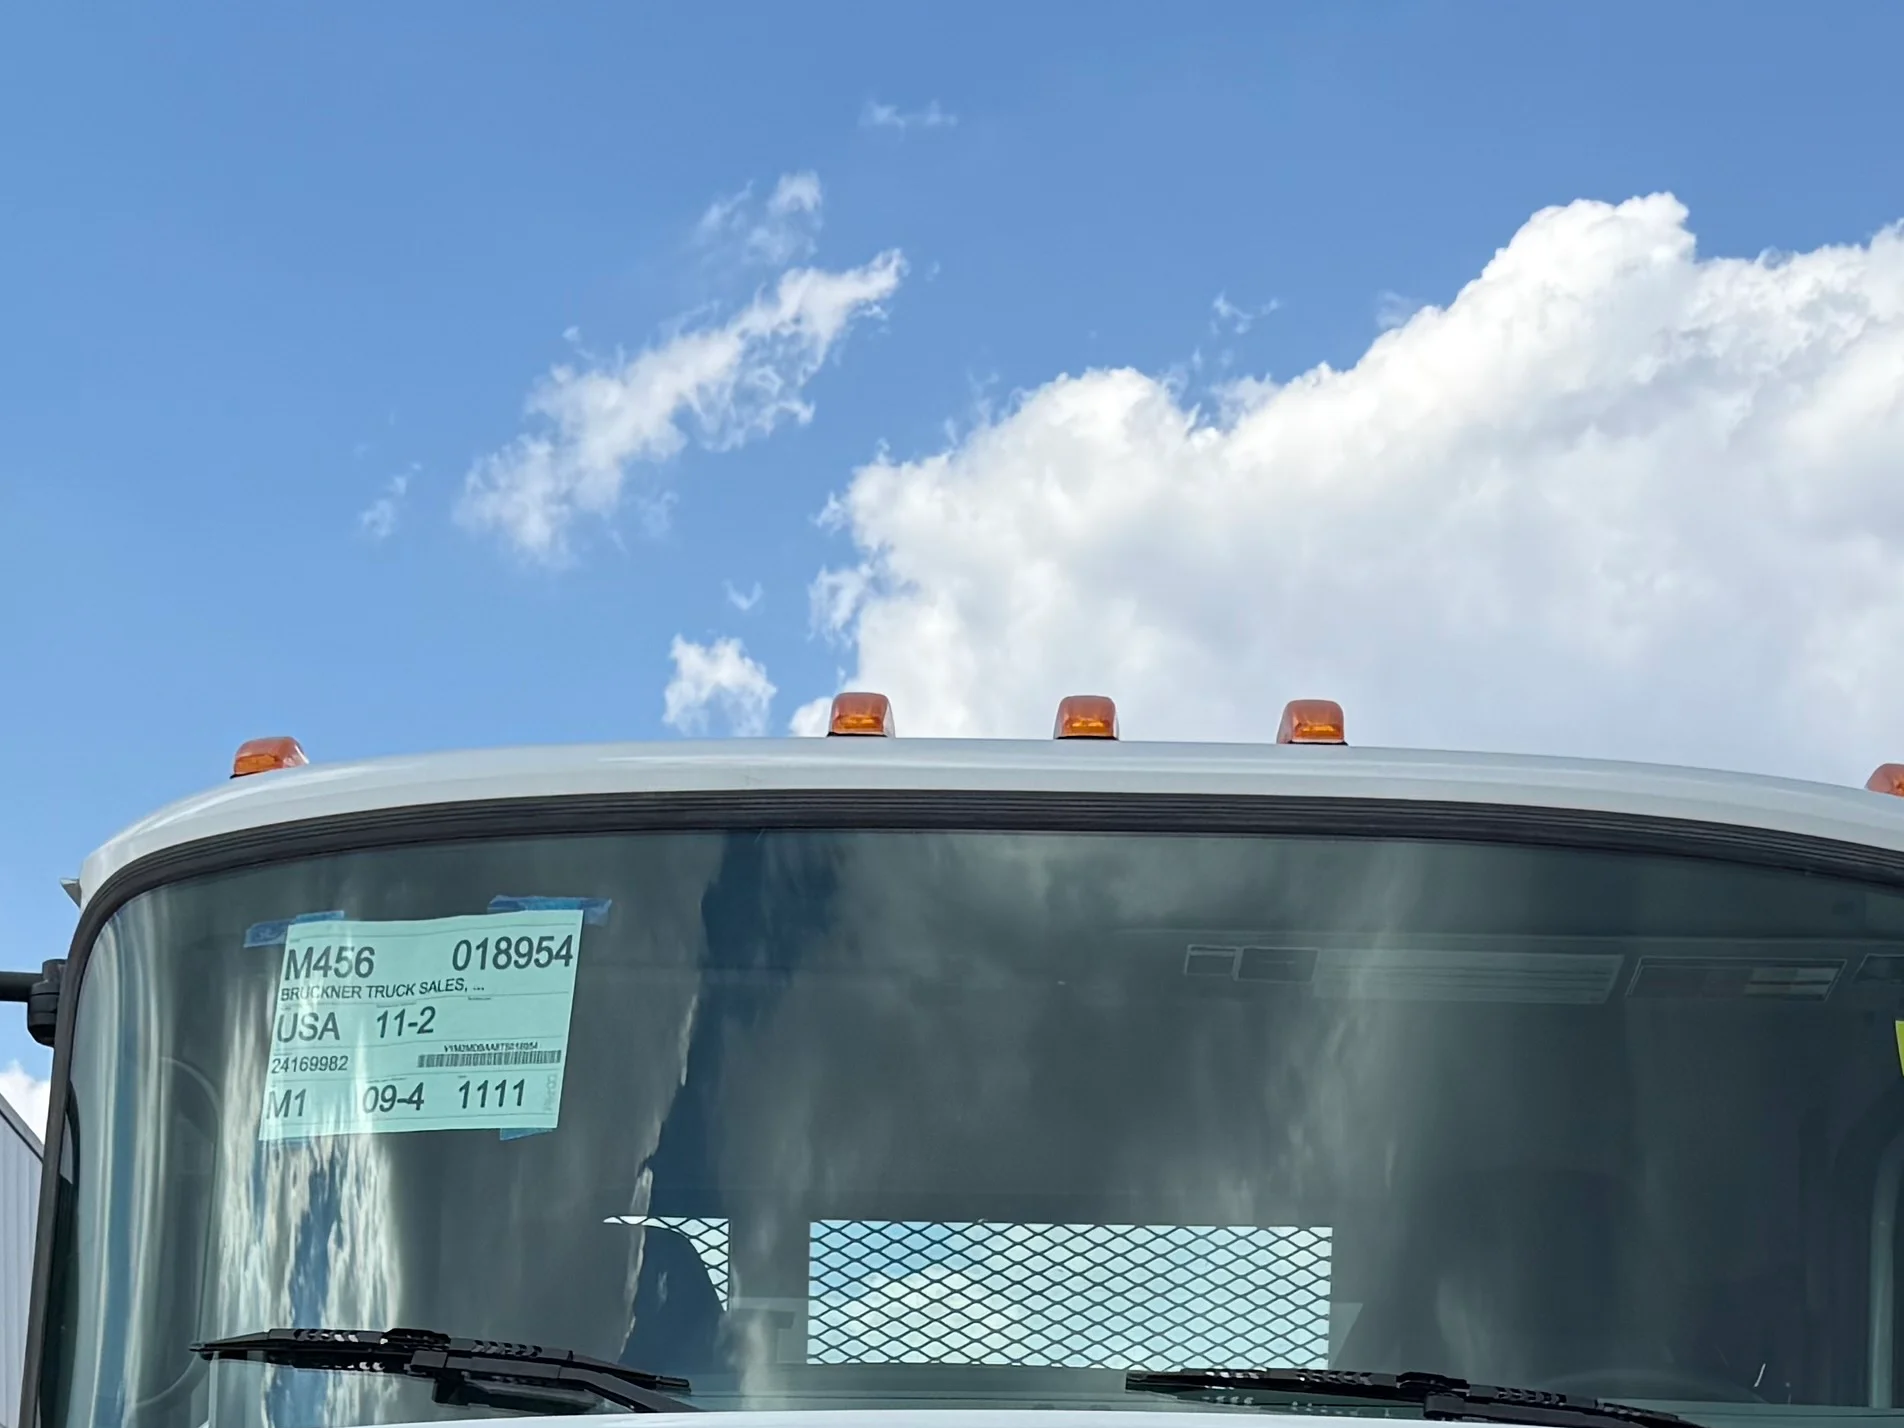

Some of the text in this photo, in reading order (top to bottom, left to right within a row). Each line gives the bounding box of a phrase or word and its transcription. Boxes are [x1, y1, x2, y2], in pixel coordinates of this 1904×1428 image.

[285, 934, 573, 980] M456 018954
[280, 985, 362, 1001] BRUCKNER
[366, 983, 415, 999] TRUCK
[419, 978, 468, 993] SALES,
[277, 1006, 436, 1043] USA 11-2
[271, 1055, 349, 1074] 24169982
[266, 1088, 307, 1120] M1
[362, 1082, 424, 1113] 09-4
[458, 1078, 526, 1109] 1111
